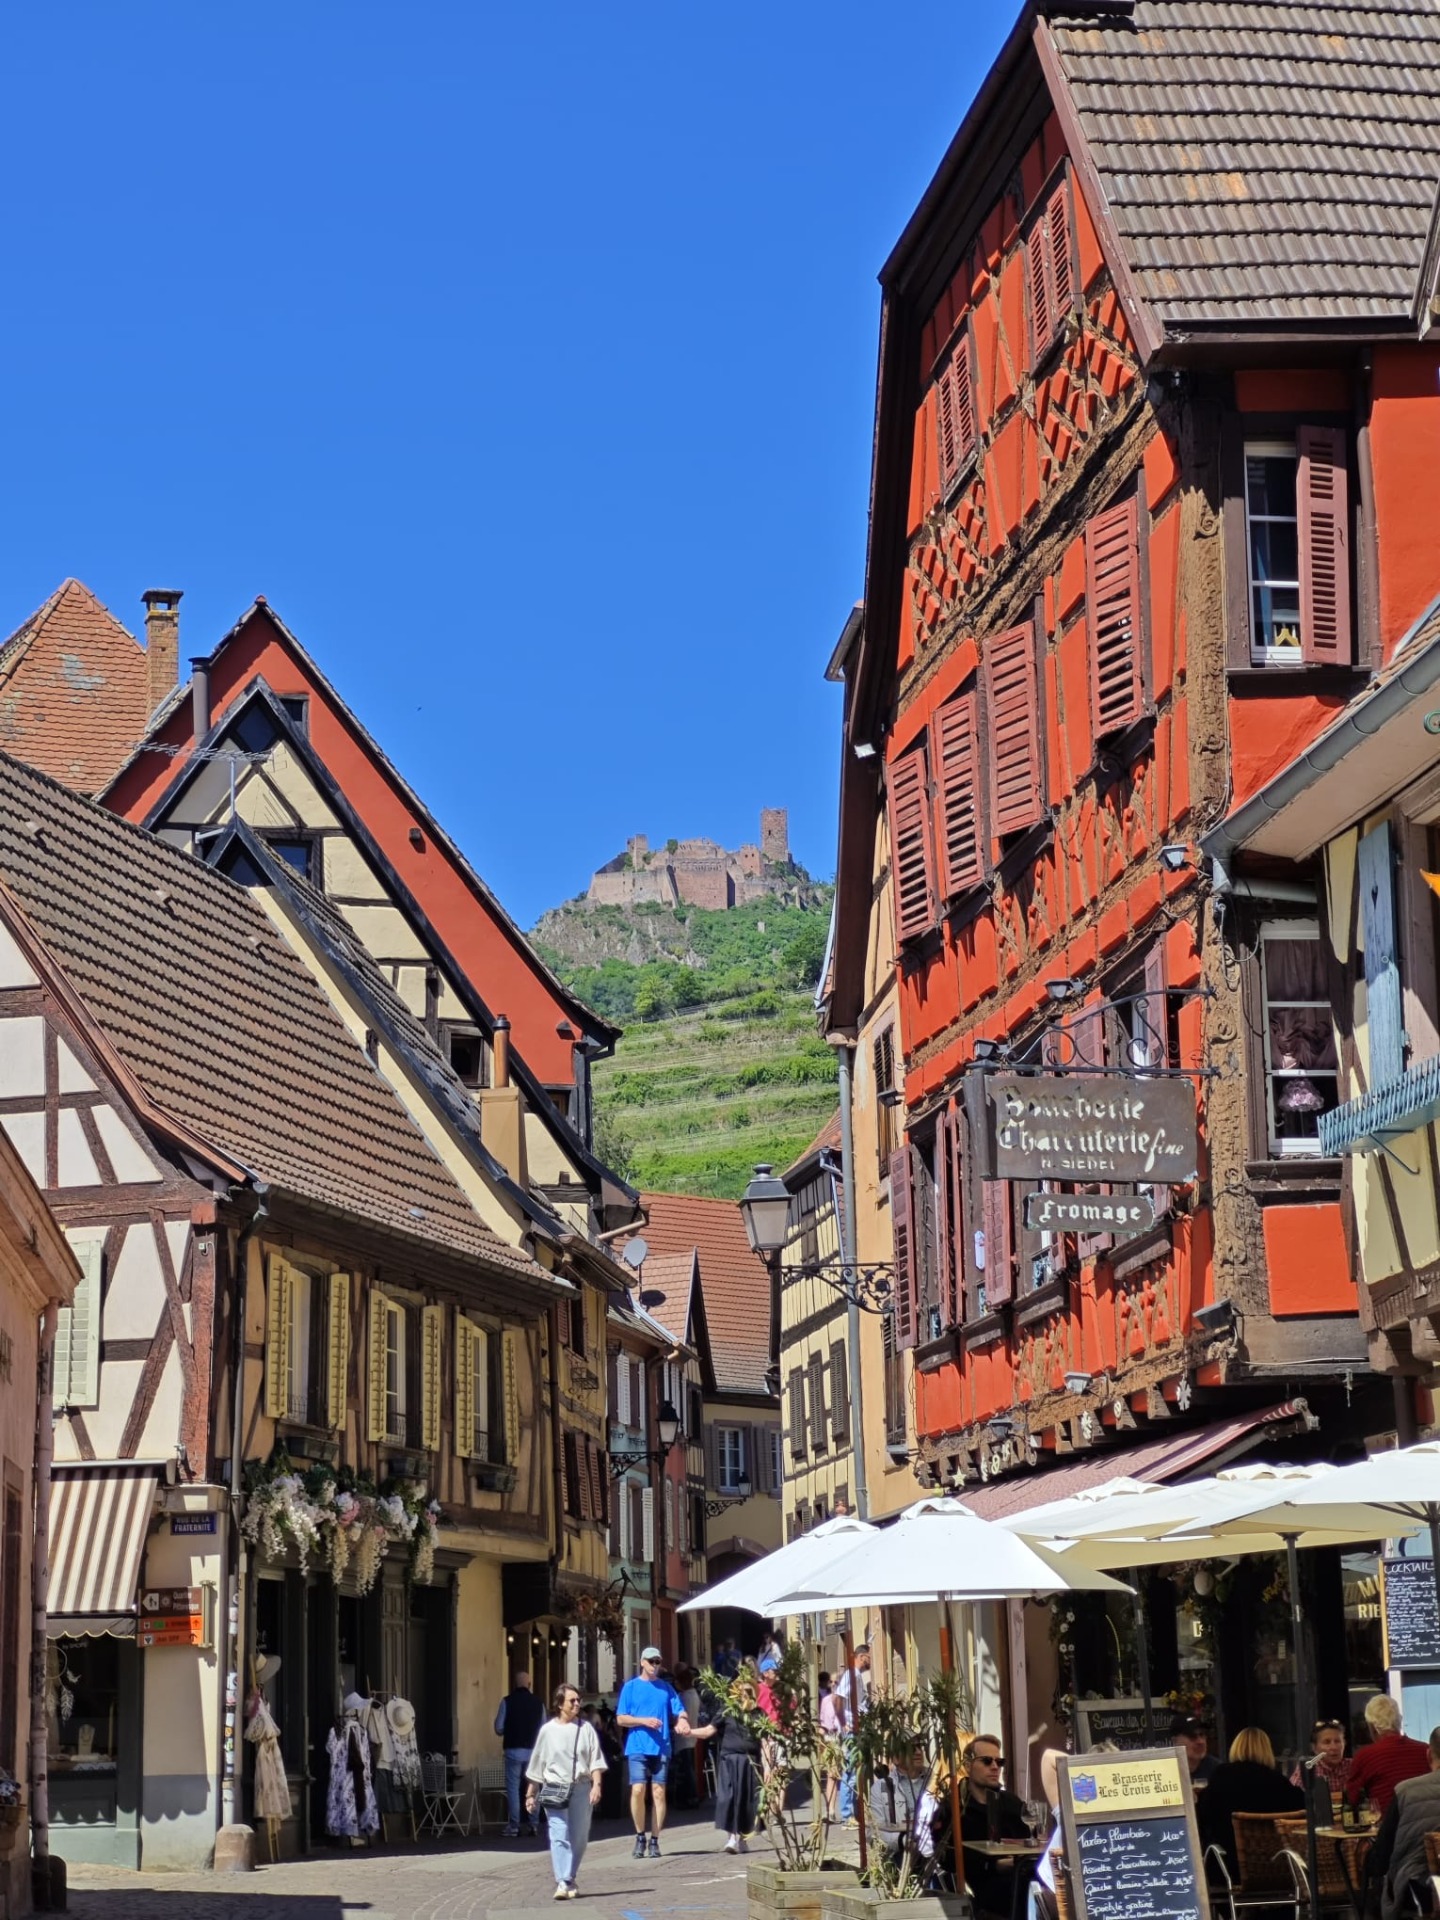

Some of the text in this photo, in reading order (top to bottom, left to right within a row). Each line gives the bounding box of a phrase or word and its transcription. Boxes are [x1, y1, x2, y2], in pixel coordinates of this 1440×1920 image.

[1000, 1086, 1145, 1120] Boucherie
[998, 1118, 1185, 1173] Charcuterie fine
[1098, 1780, 1179, 1798] Les Trois Rois
[1112, 1770, 1162, 1785] Brasserie
